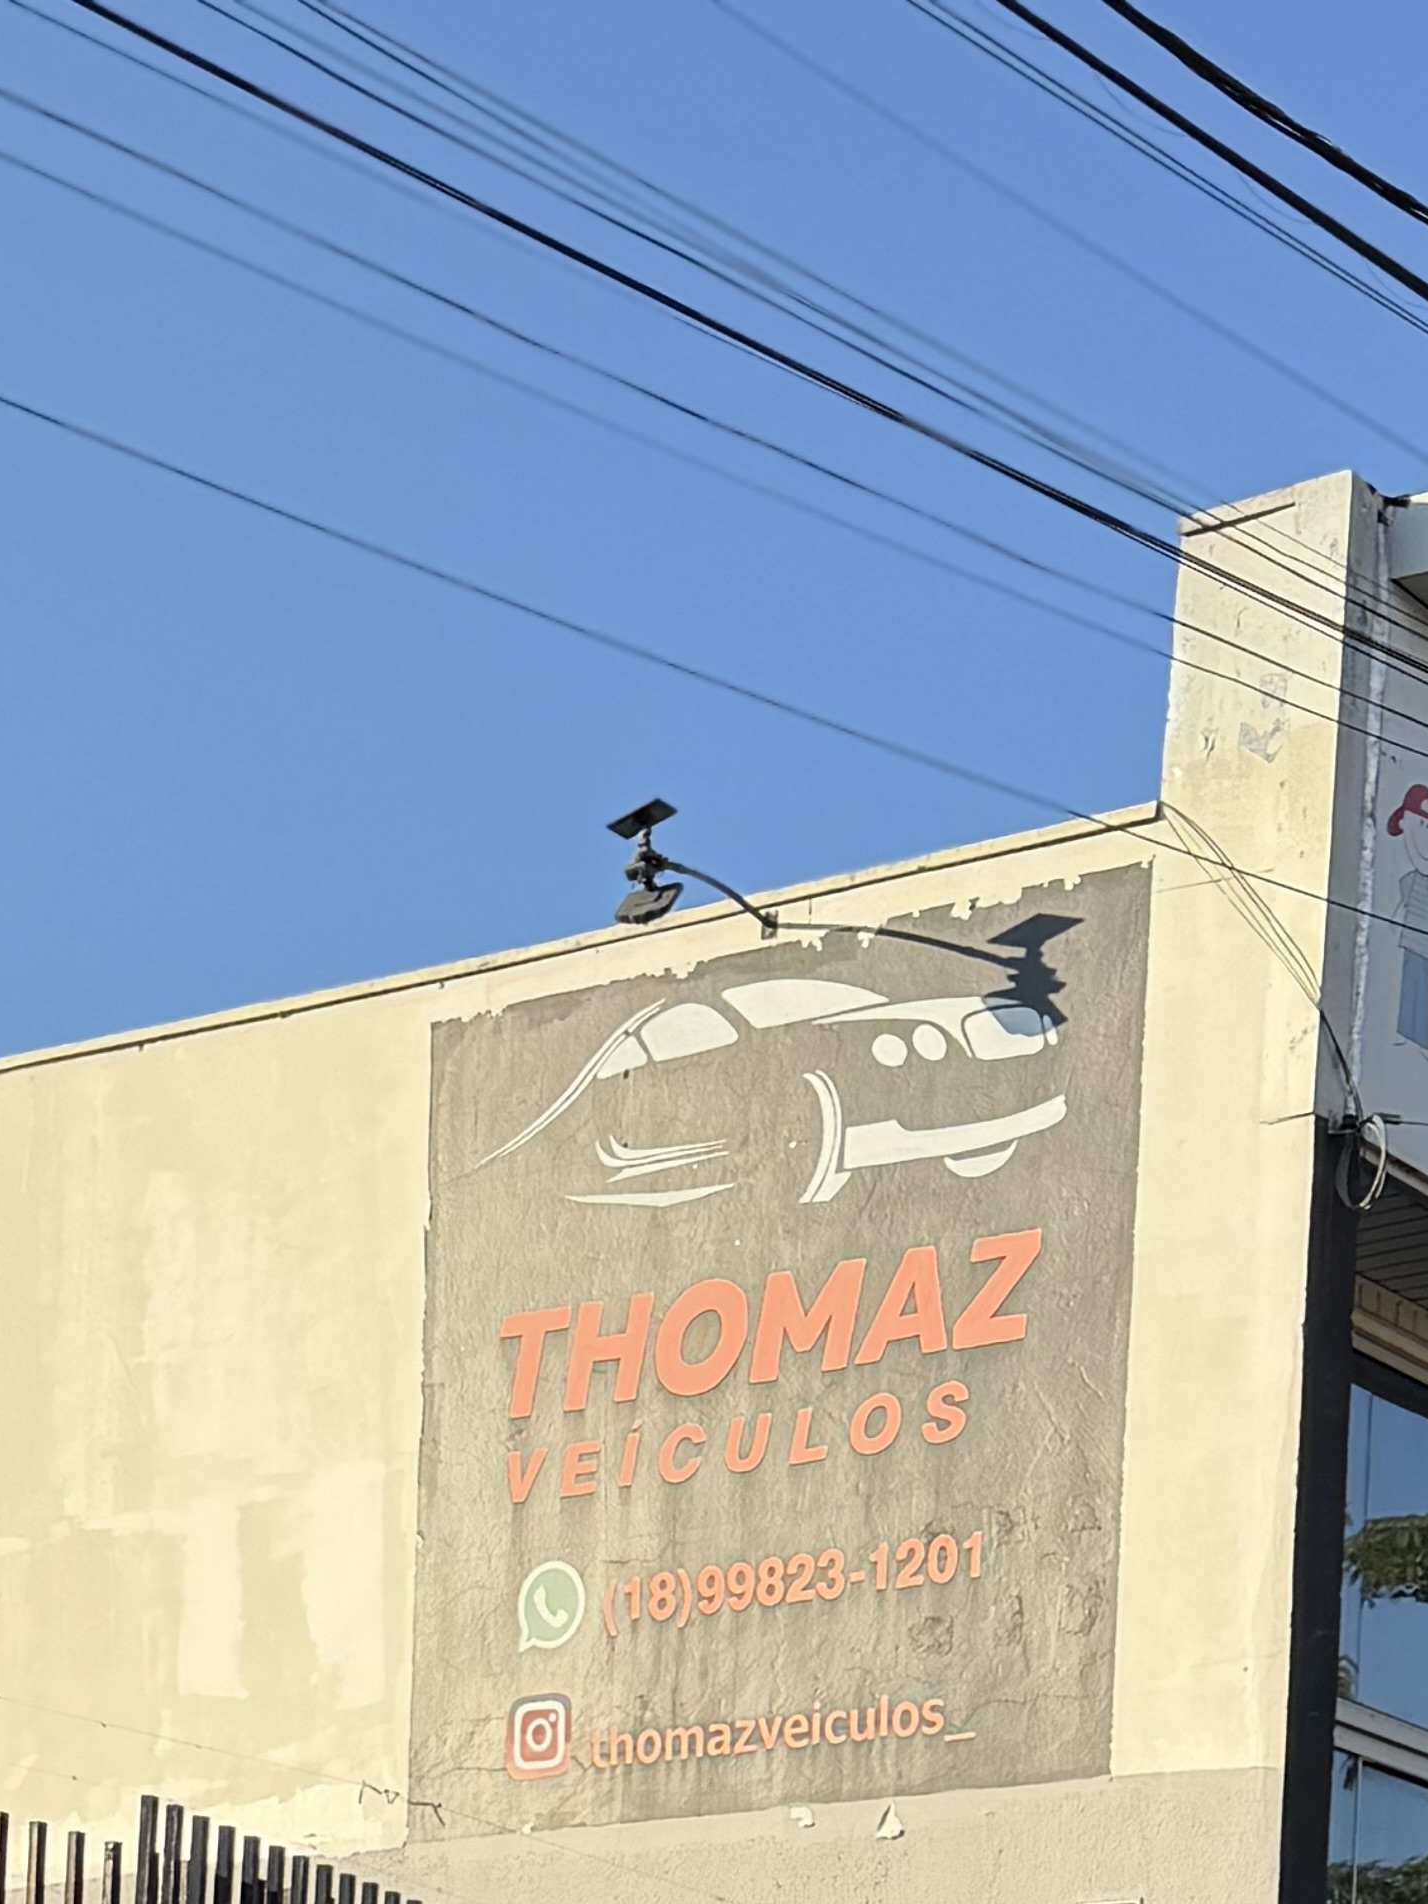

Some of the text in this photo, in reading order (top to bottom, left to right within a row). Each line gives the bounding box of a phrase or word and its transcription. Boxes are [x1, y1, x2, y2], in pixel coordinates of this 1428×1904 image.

[499, 1228, 1043, 1421] THOMAZ
[507, 1381, 972, 1505] VEÍCULOS
[602, 1530, 984, 1637] (18)99823-1201
